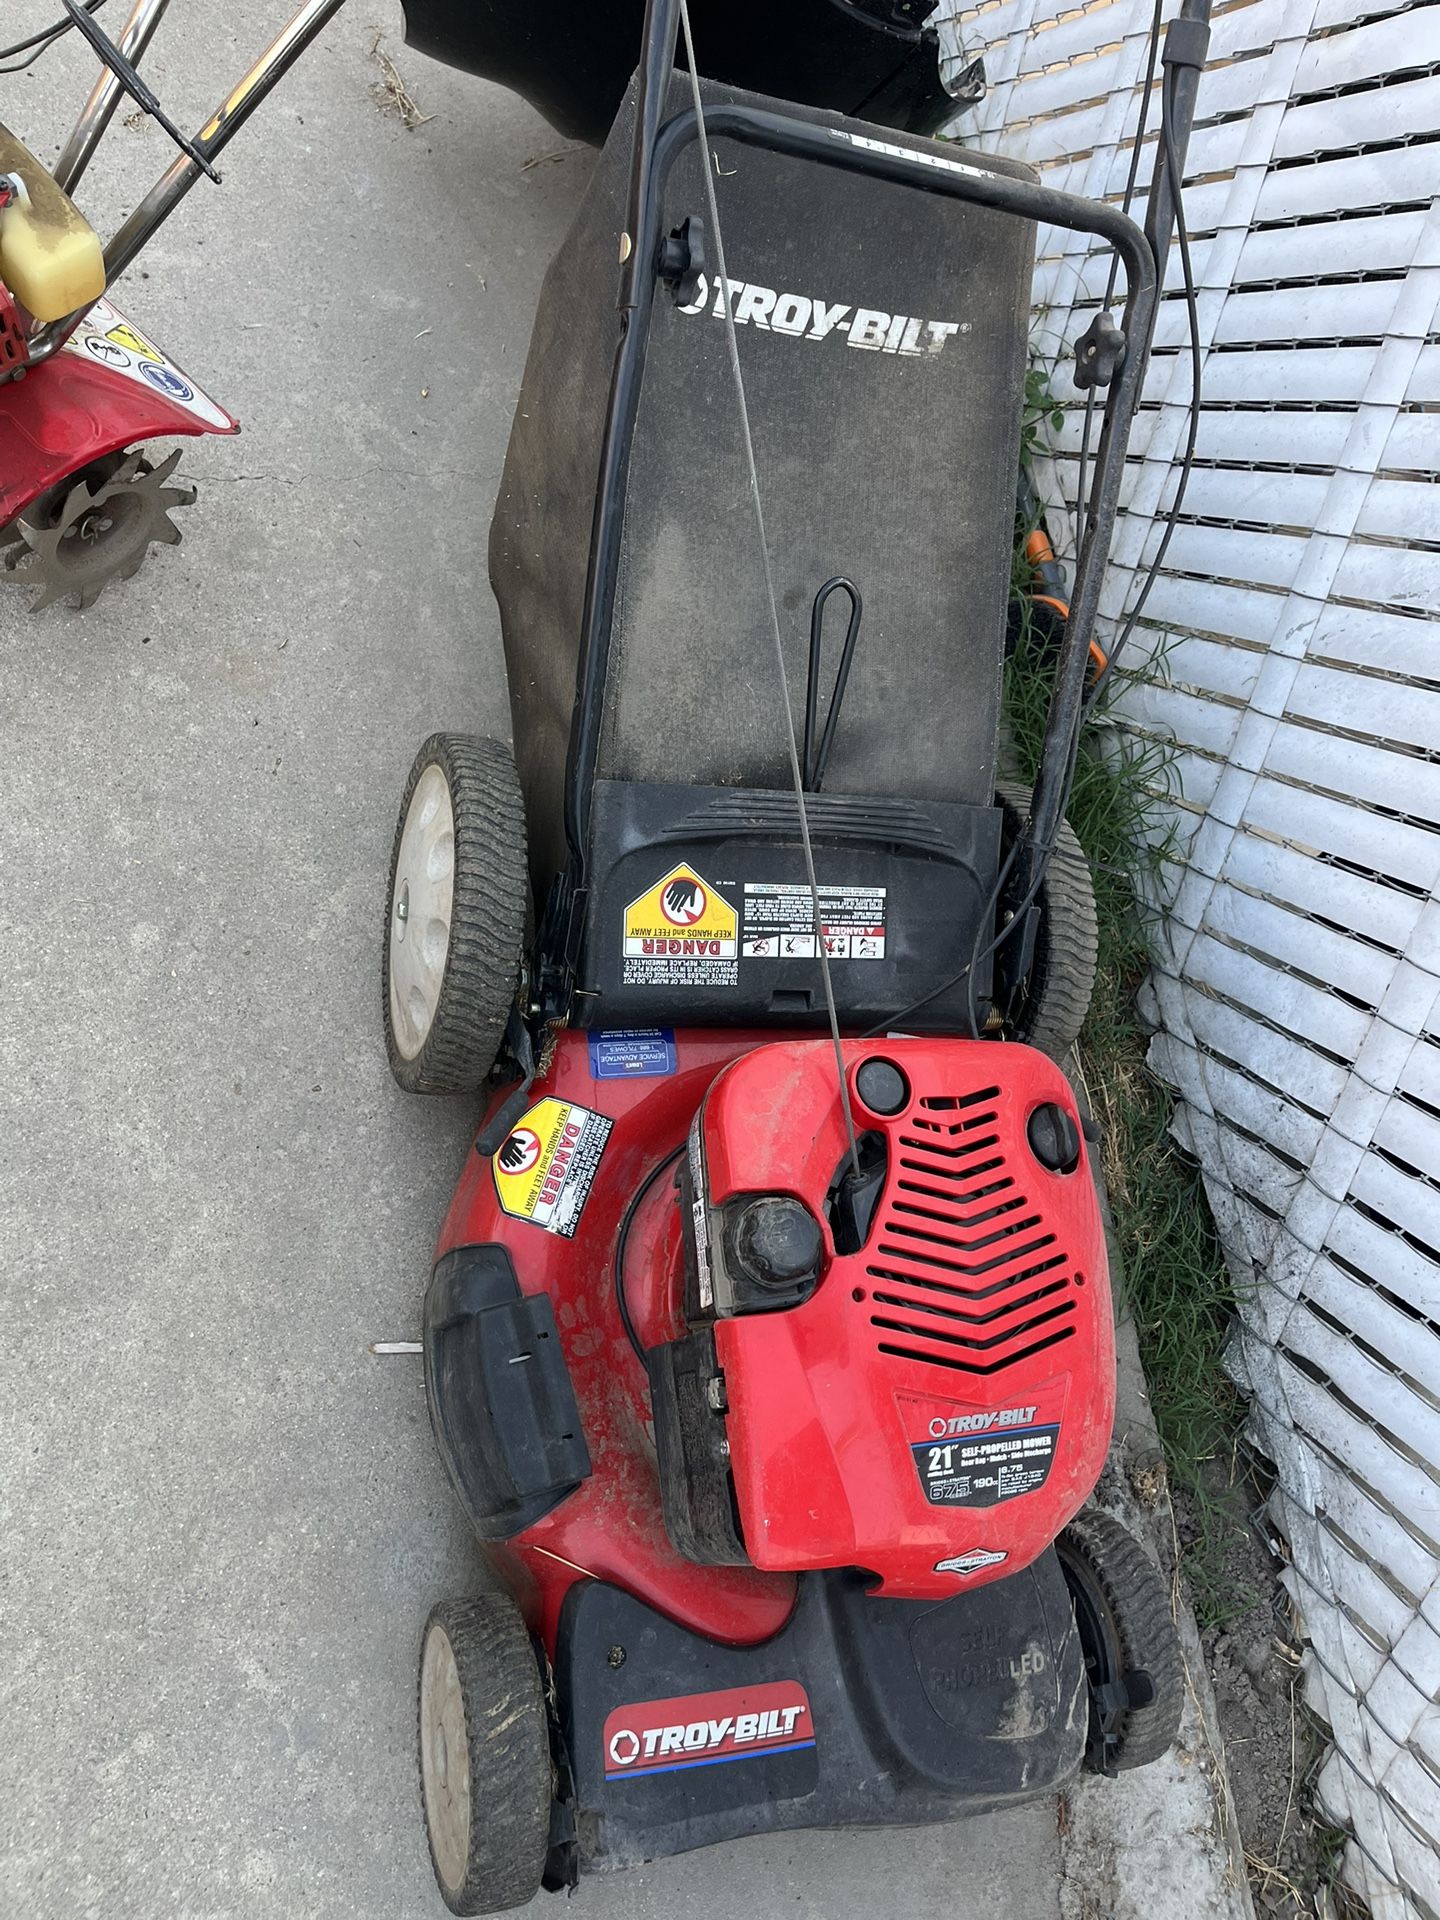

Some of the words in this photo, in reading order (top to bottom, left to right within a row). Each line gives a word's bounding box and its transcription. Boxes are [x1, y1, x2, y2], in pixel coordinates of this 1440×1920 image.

[712, 276, 960, 356] TROY-BILT
[630, 928, 652, 936] AWAY
[653, 928, 670, 936] FEET
[672, 929, 686, 937] and
[687, 929, 713, 938] HANDS
[714, 930, 732, 938] KEEP
[828, 926, 865, 935] DANGER
[642, 939, 721, 955] DANGER
[601, 1054, 638, 1063] ADVANTAGE
[557, 1108, 568, 1128] KEEP
[591, 1116, 602, 1134] GRASS
[606, 1120, 612, 1129] TO
[593, 1118, 607, 1144] OPERATE
[546, 1128, 560, 1154] HANDS
[582, 1134, 595, 1161] CATCHER
[597, 1128, 610, 1153] REDUCE
[539, 1122, 580, 1206] DANGER
[540, 1155, 549, 1169] and
[584, 1146, 597, 1170] UNLESS
[592, 1153, 601, 1165] THE
[534, 1169, 546, 1186] FEET
[588, 1165, 596, 1180] RISK
[585, 1180, 590, 1190] OF
[524, 1189, 538, 1212] AWAY
[572, 1213, 579, 1223] DO
[948, 1406, 1037, 1434] TROY-BILT
[961, 1439, 1022, 1458] SELF-PROPELLED
[1023, 1436, 1052, 1449] MOWER
[1024, 1448, 1052, 1457] Discharge
[1001, 1464, 1023, 1474] 6.75
[930, 1480, 970, 1500] 675
[642, 1706, 802, 1758] TROY-BILT
